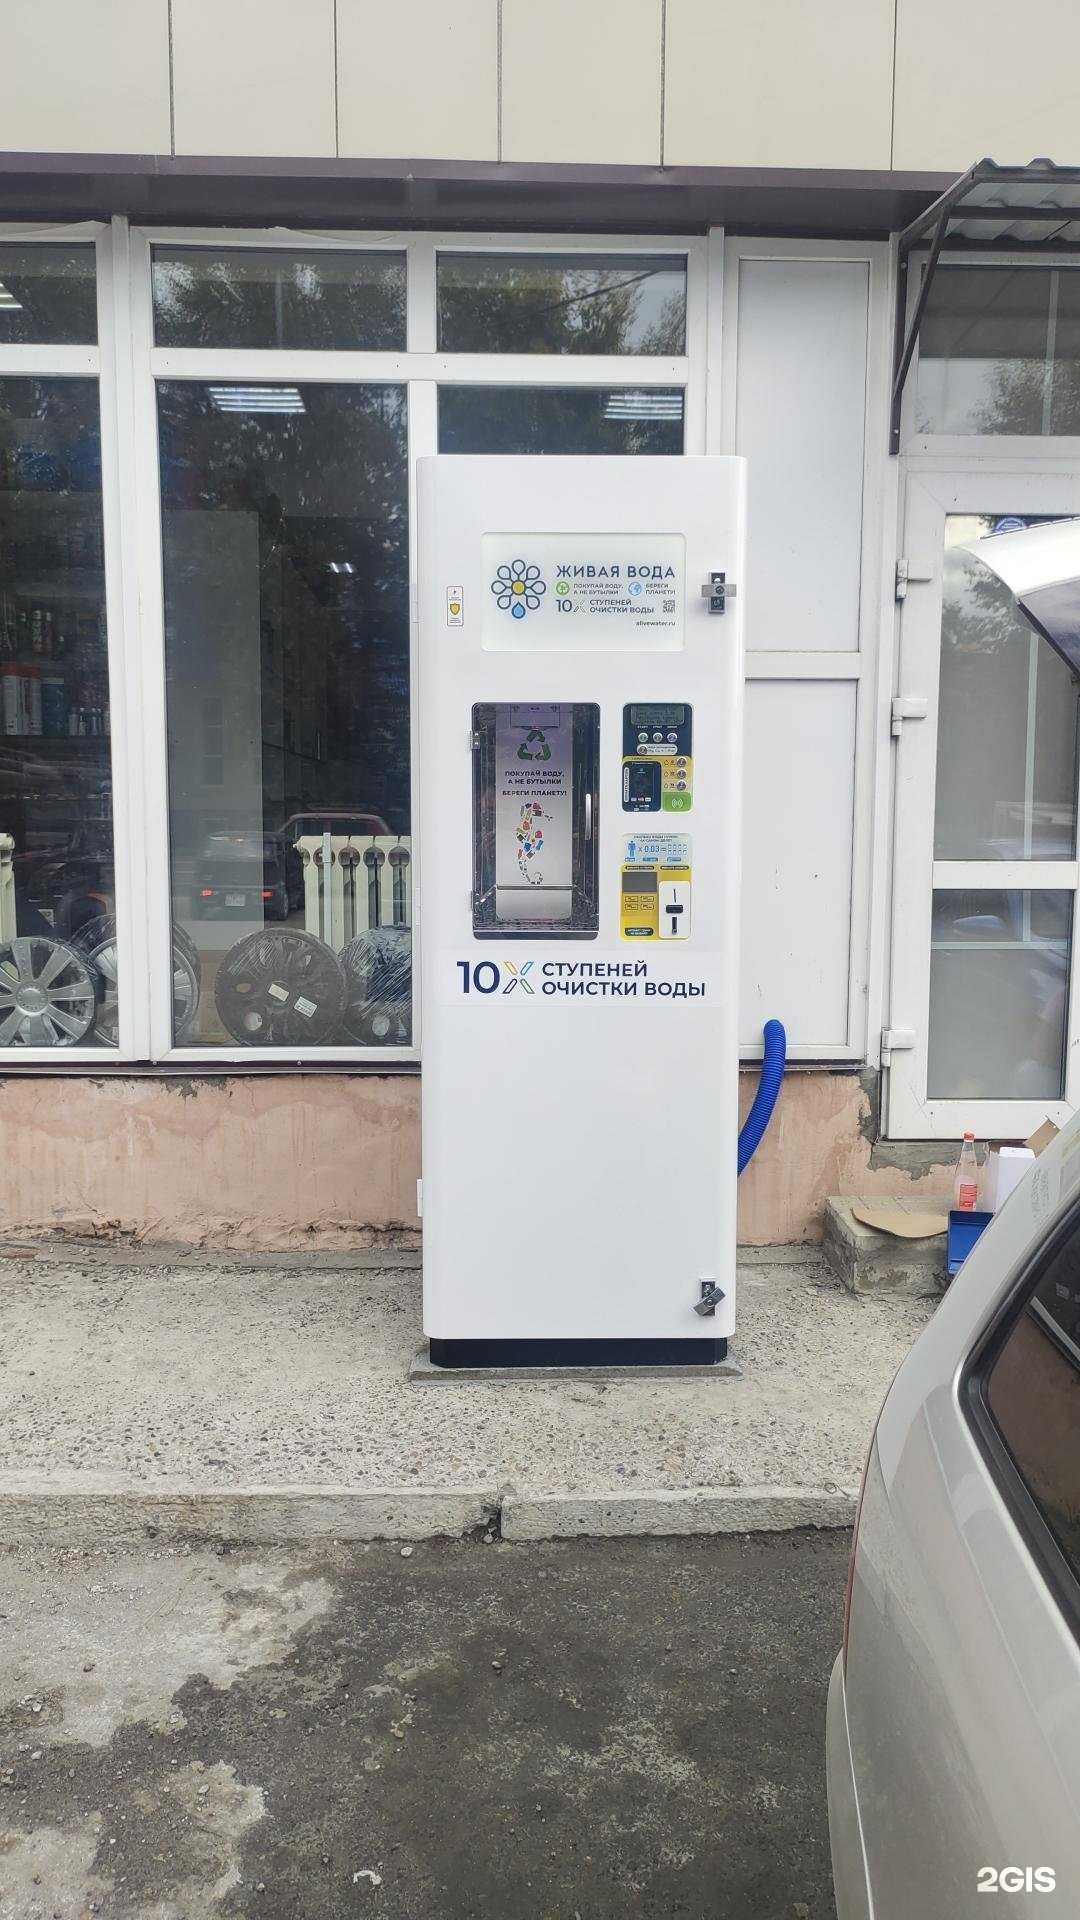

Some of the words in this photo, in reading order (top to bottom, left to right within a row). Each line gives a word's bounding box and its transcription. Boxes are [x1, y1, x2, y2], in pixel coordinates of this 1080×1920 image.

[557, 565, 620, 577] ЖИВАЯ
[628, 566, 675, 579] ВОДА
[542, 960, 647, 976] СТУПЕНЕЙ
[542, 982, 637, 995] ОЧИСТКИ
[645, 983, 705, 998] ВОДЫ
